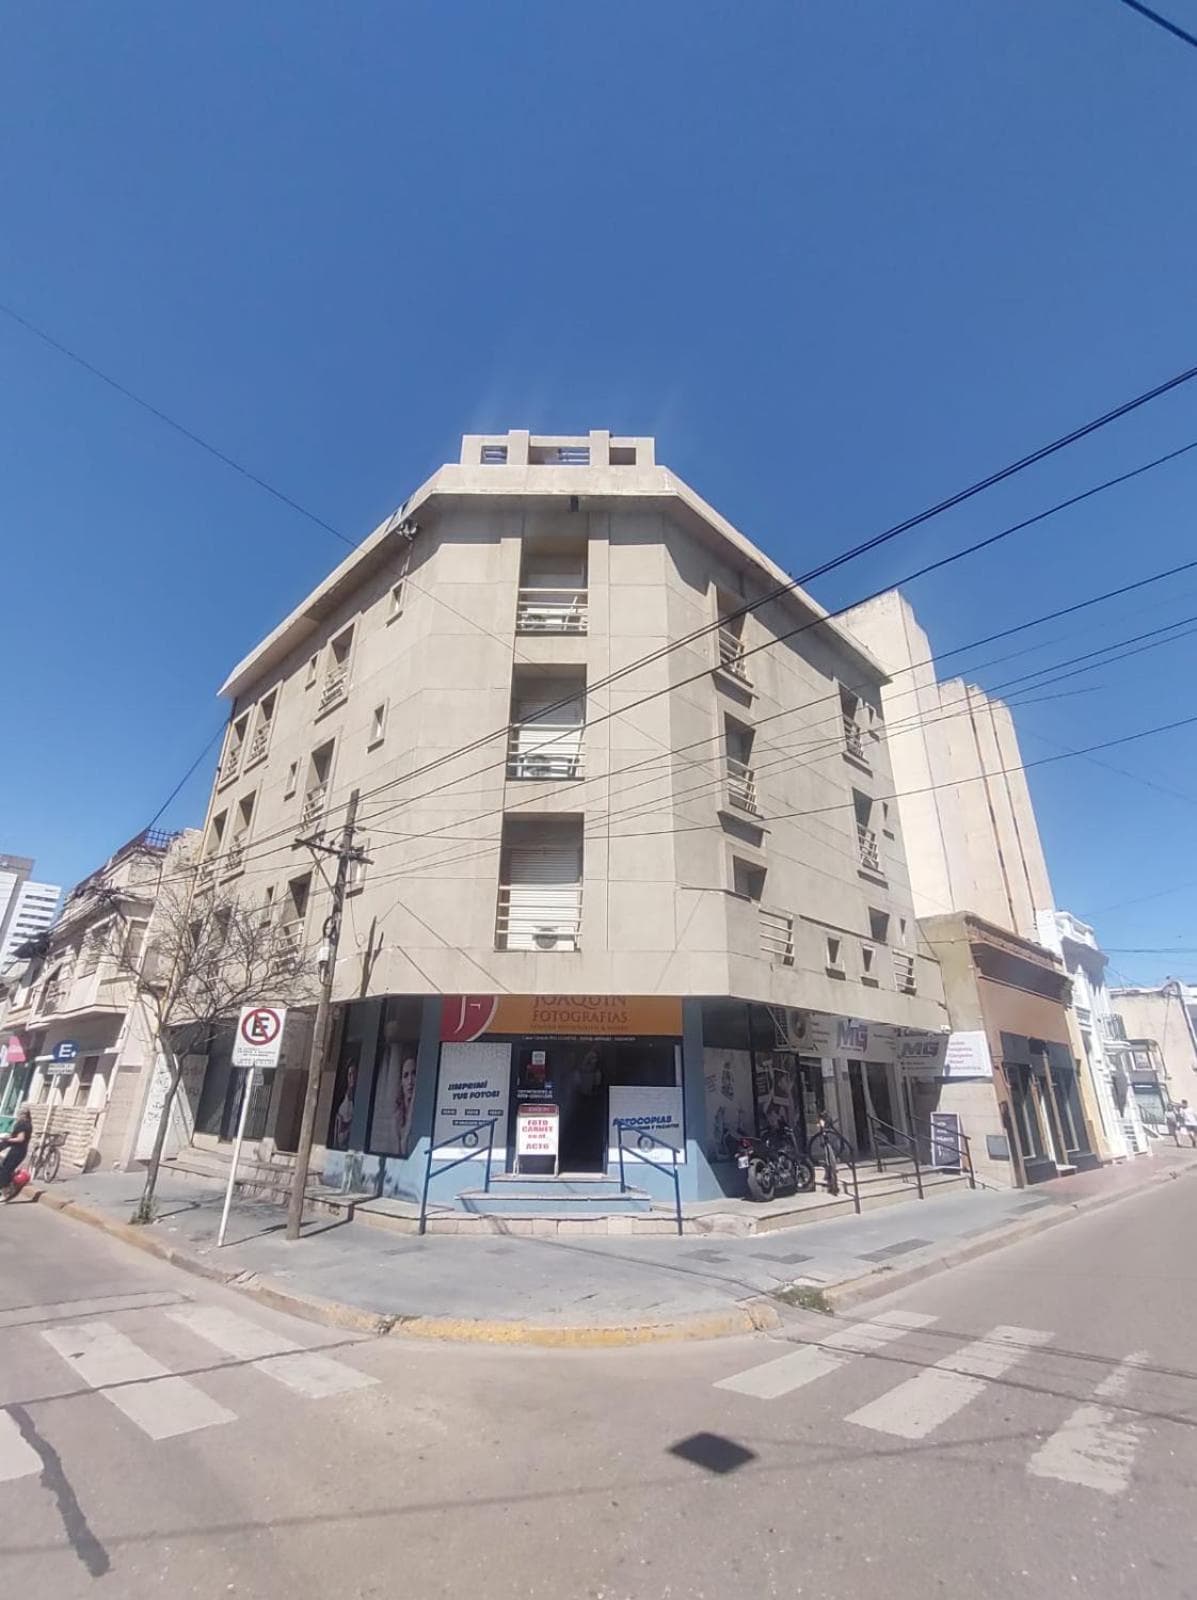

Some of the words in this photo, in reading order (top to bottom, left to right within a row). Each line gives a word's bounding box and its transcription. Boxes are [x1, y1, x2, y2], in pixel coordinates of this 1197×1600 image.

[531, 1009, 629, 1024] FOTOGRAFIAS
[252, 1016, 270, 1037] E
[58, 1043, 73, 1058] E
